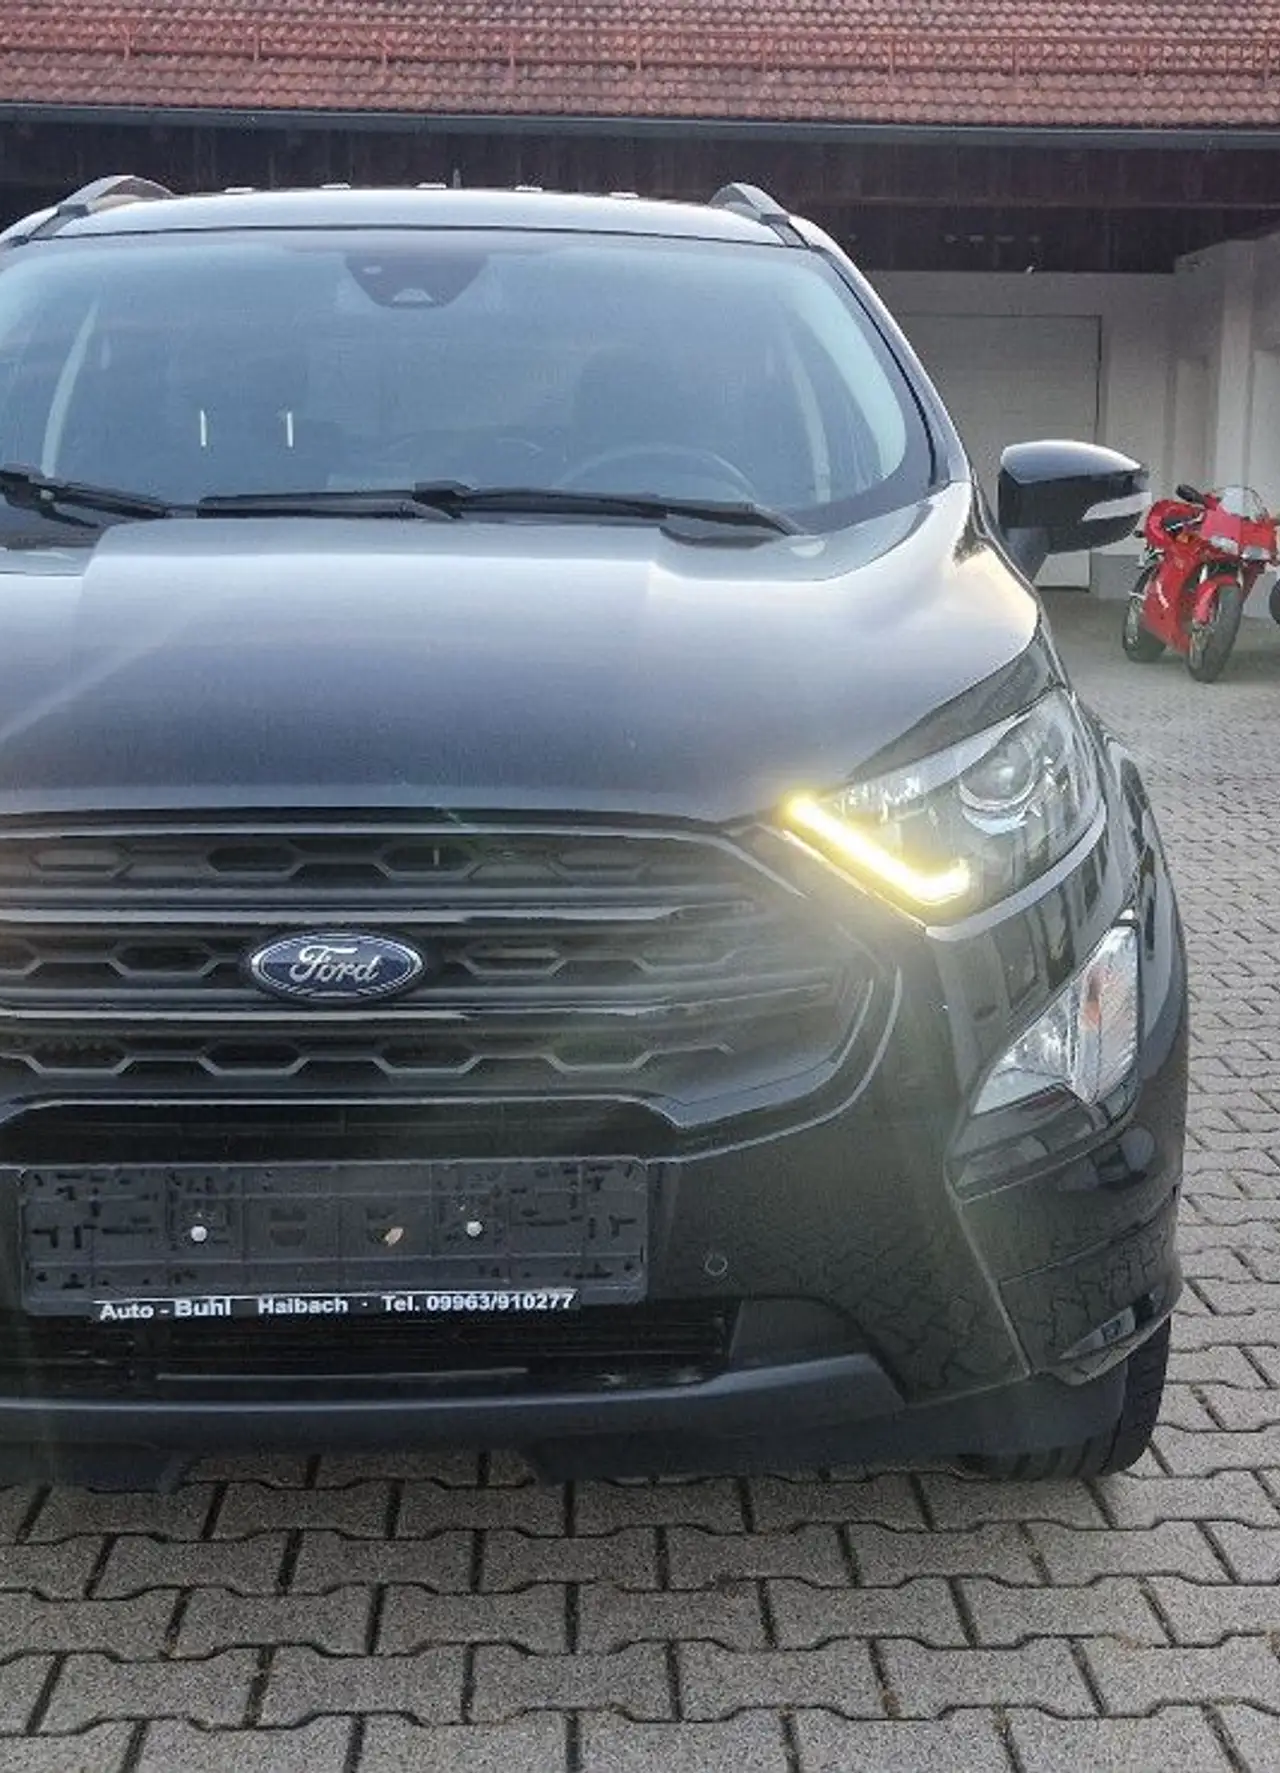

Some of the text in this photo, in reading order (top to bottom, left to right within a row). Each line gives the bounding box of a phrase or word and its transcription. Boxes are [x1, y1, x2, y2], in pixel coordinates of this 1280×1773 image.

[289, 945, 380, 983] Ford
[99, 1302, 154, 1321] Auto
[173, 1298, 232, 1317] Buhl
[257, 1295, 349, 1315] Haibach
[381, 1295, 420, 1312] Tel.
[426, 1292, 574, 1312] 09963/910277
